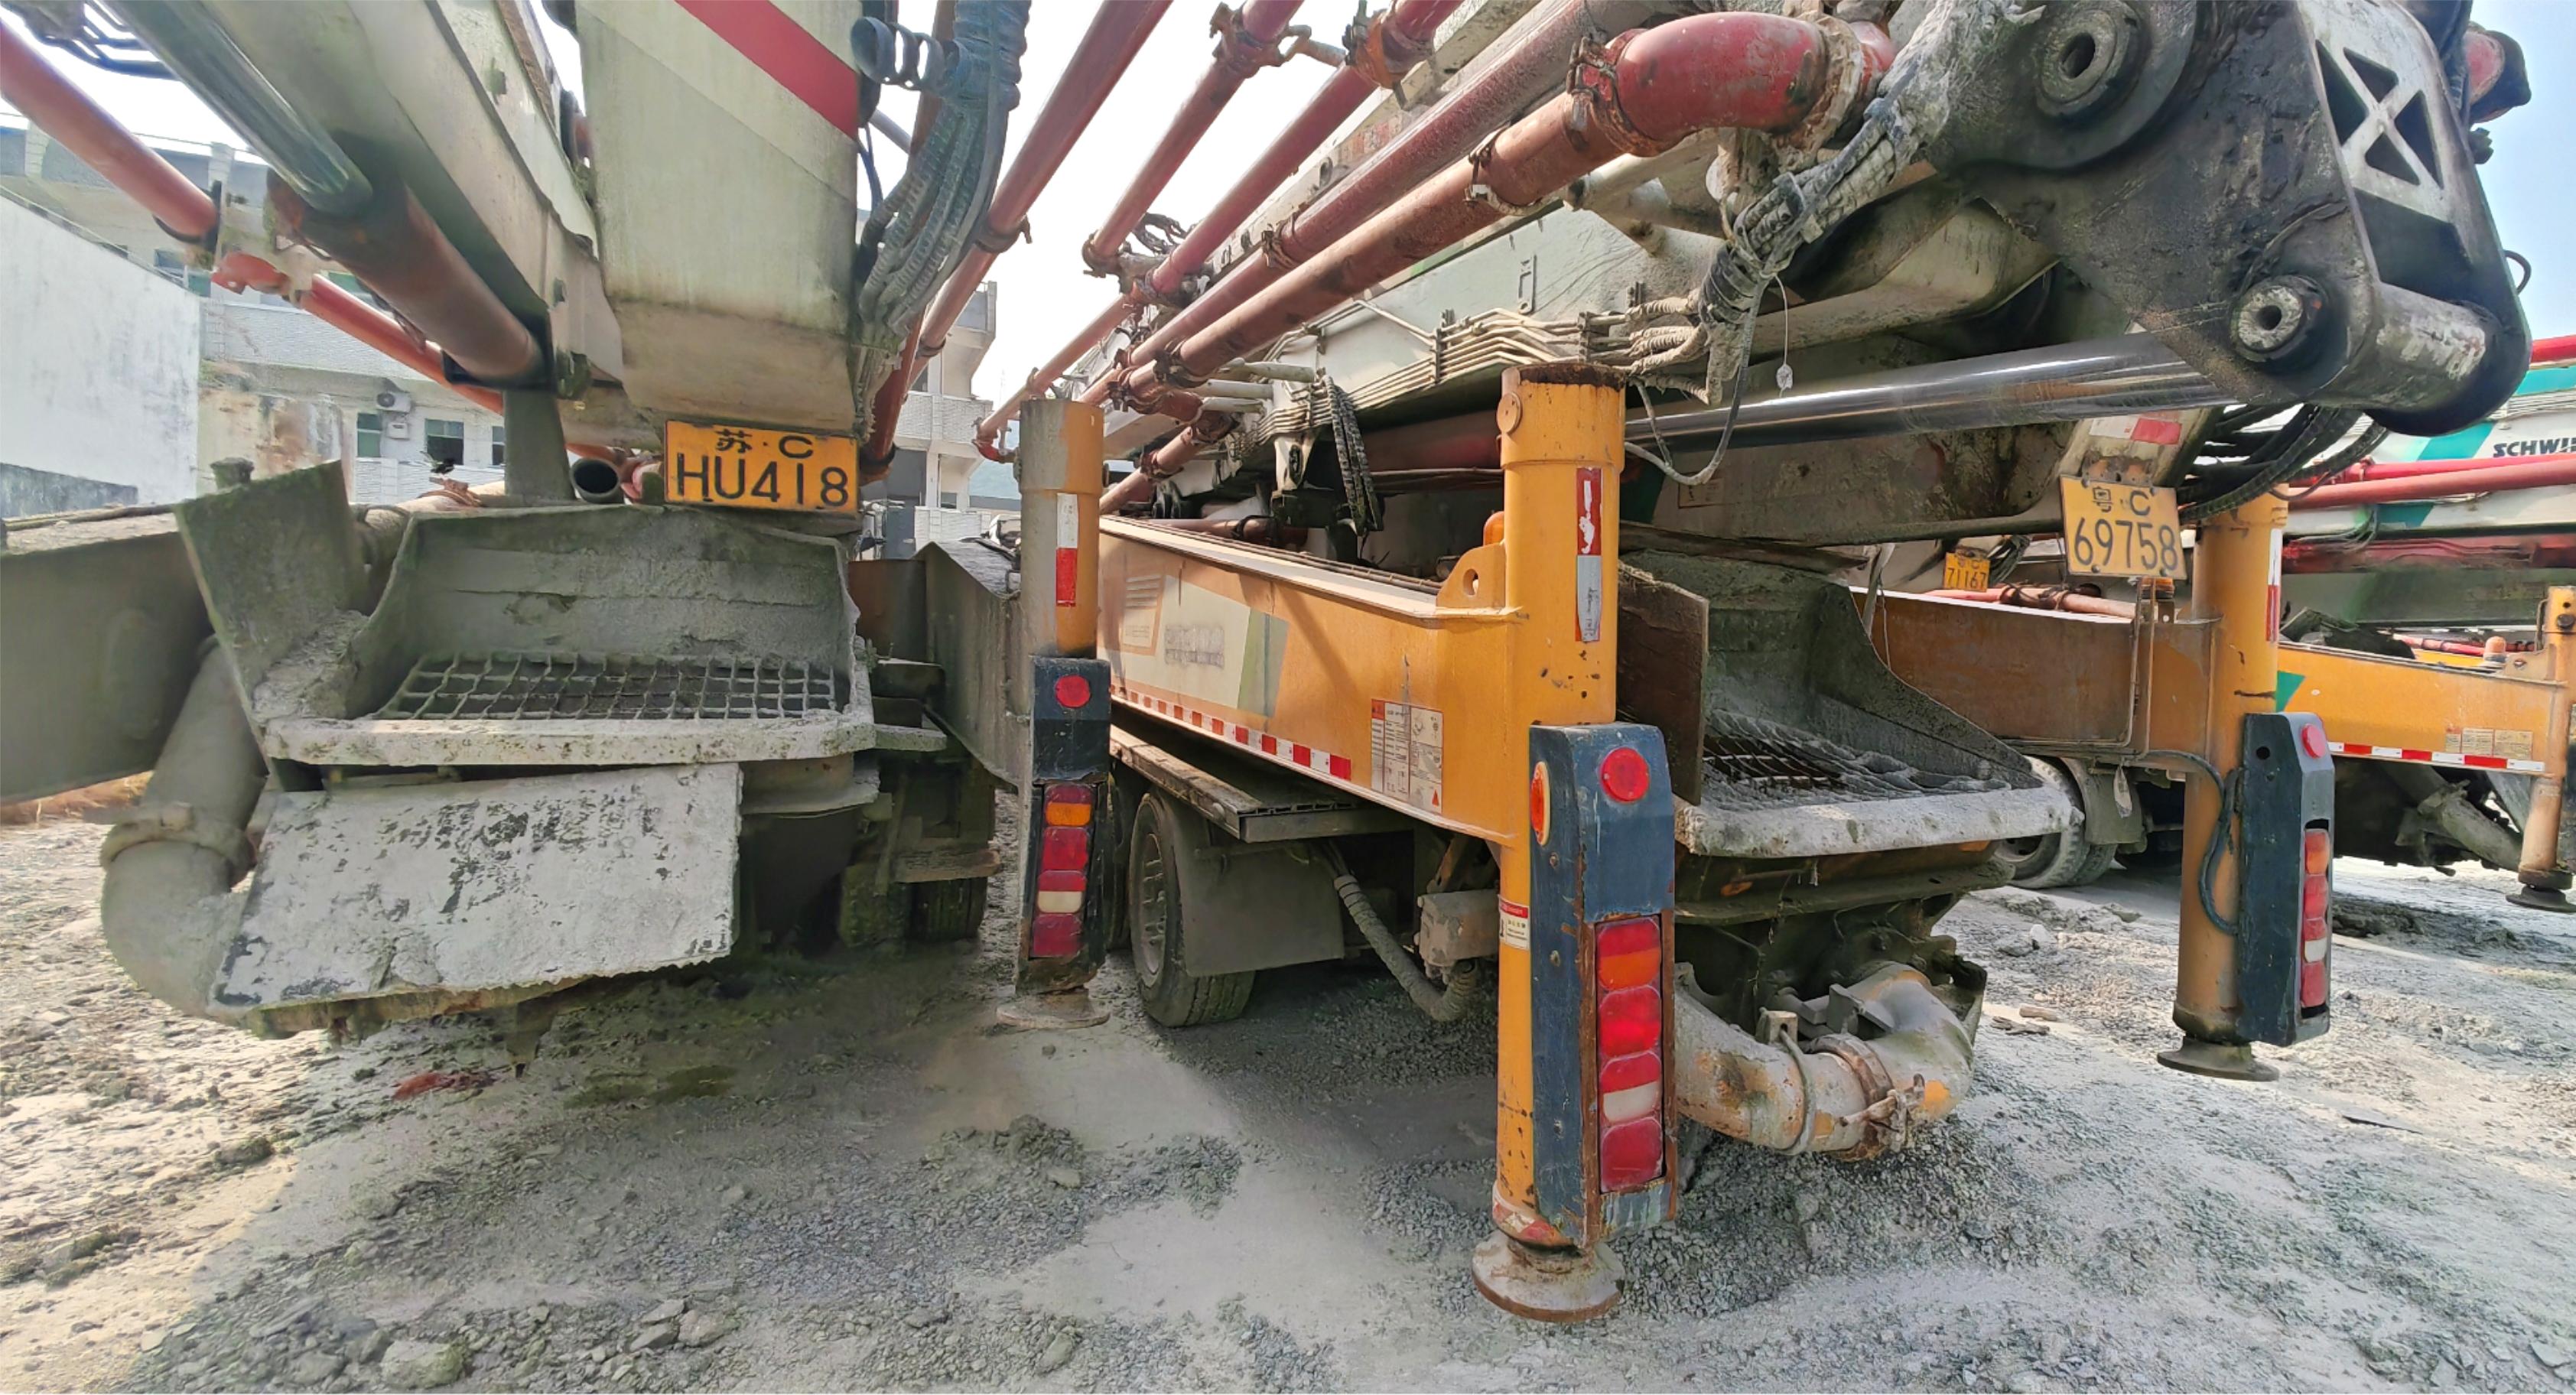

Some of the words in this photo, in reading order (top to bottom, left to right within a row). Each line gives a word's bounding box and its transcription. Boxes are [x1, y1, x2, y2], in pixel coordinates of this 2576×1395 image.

[677, 453, 849, 507] HU418
[2074, 517, 2178, 571] 69758
[1947, 567, 1987, 589] 71167
